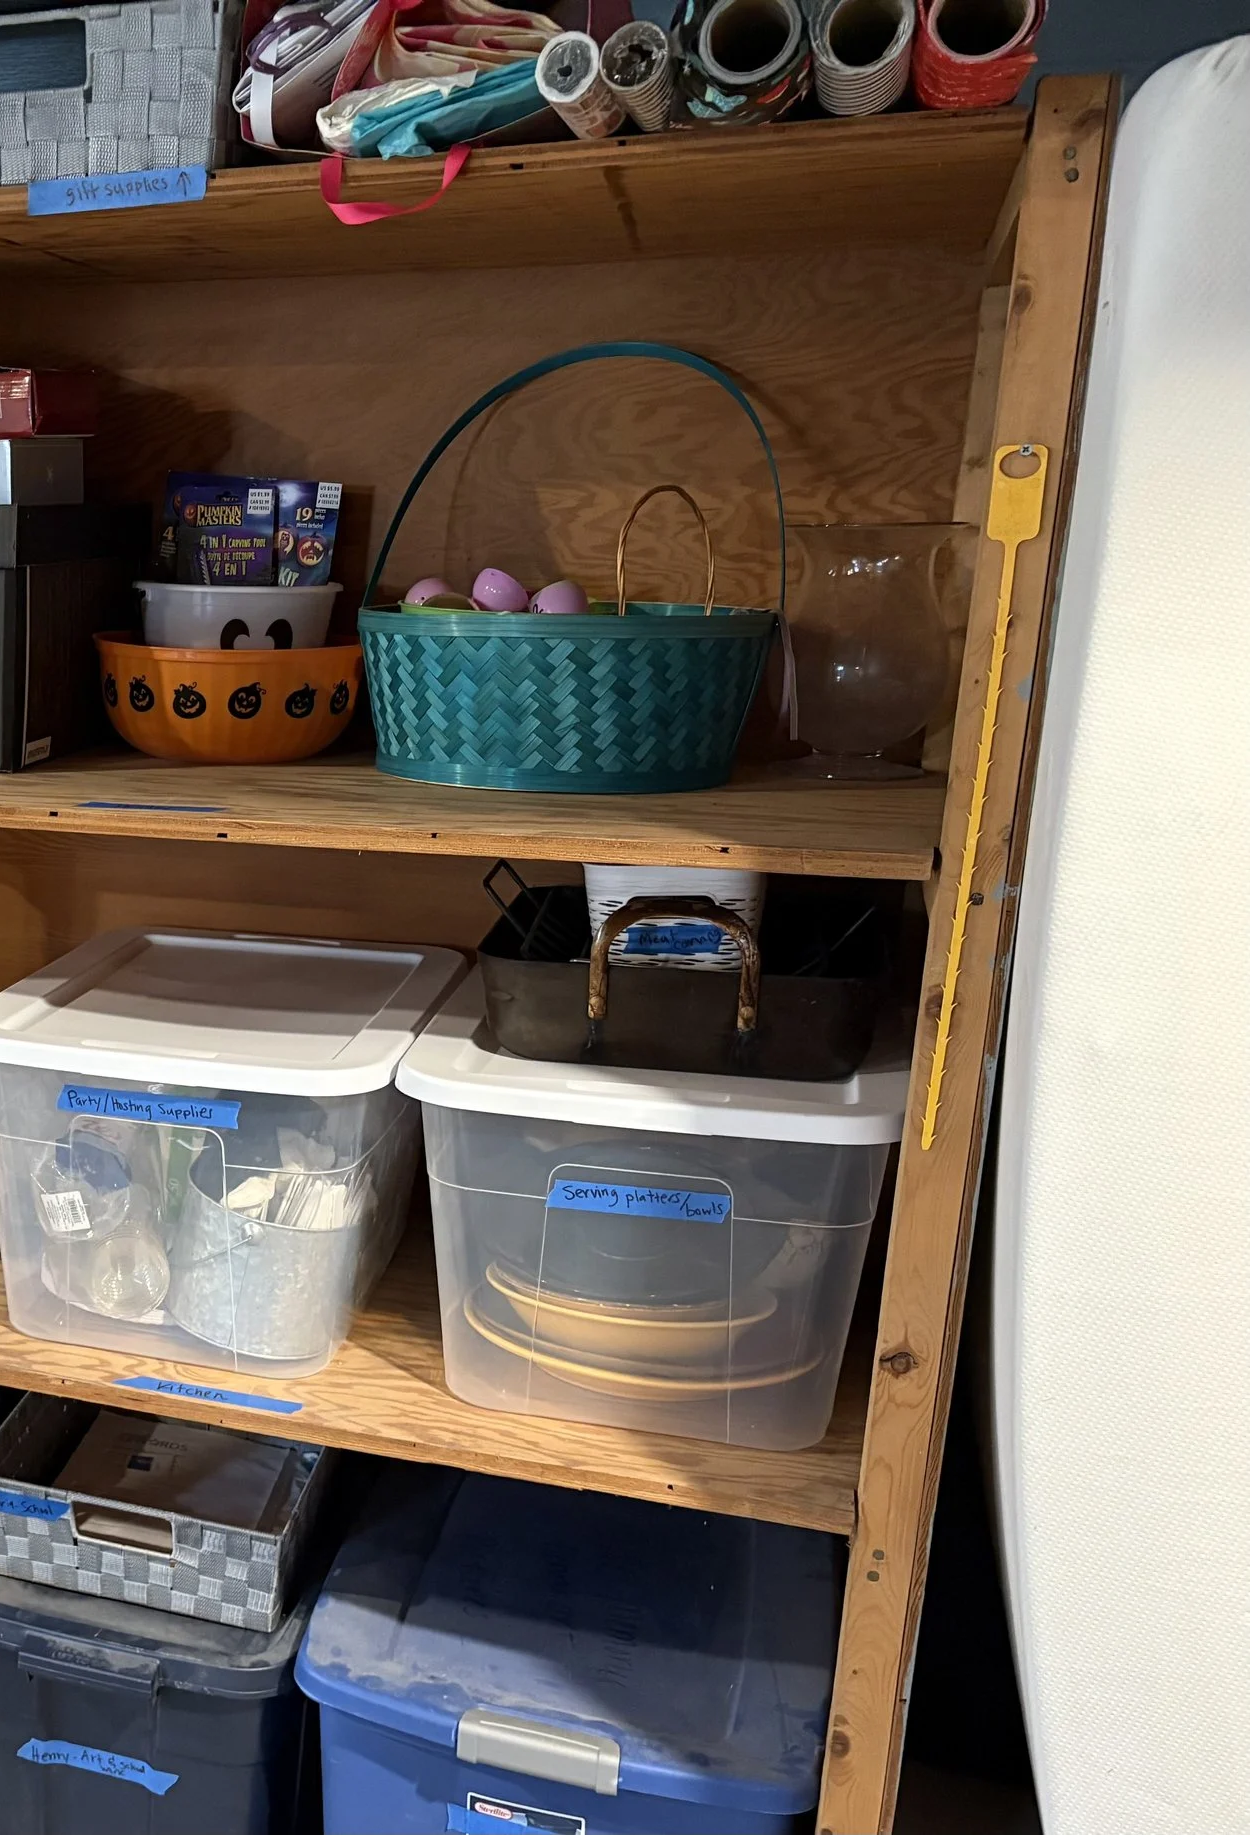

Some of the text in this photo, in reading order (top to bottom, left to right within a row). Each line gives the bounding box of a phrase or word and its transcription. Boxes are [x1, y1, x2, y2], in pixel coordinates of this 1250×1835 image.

[66, 176, 168, 205] gift supplies
[197, 505, 242, 518] PUMPKIN
[296, 508, 312, 521] 19
[196, 515, 242, 526] MASTERS
[163, 526, 175, 540] 4
[200, 535, 207, 548] 4
[209, 536, 219, 549] IN
[222, 535, 227, 548] 1
[213, 562, 220, 576] 4
[224, 563, 237, 576] EN
[278, 567, 300, 586] KIT
[159, 1103, 213, 1120] Supplies
[562, 1185, 619, 1207] Serving
[686, 1200, 724, 1217] bowls
[157, 1381, 227, 1401] Kitchen
[31, 1746, 69, 1763] Henry
[81, 1750, 102, 1764] Art
[478, 1804, 510, 1818] Sterilite
